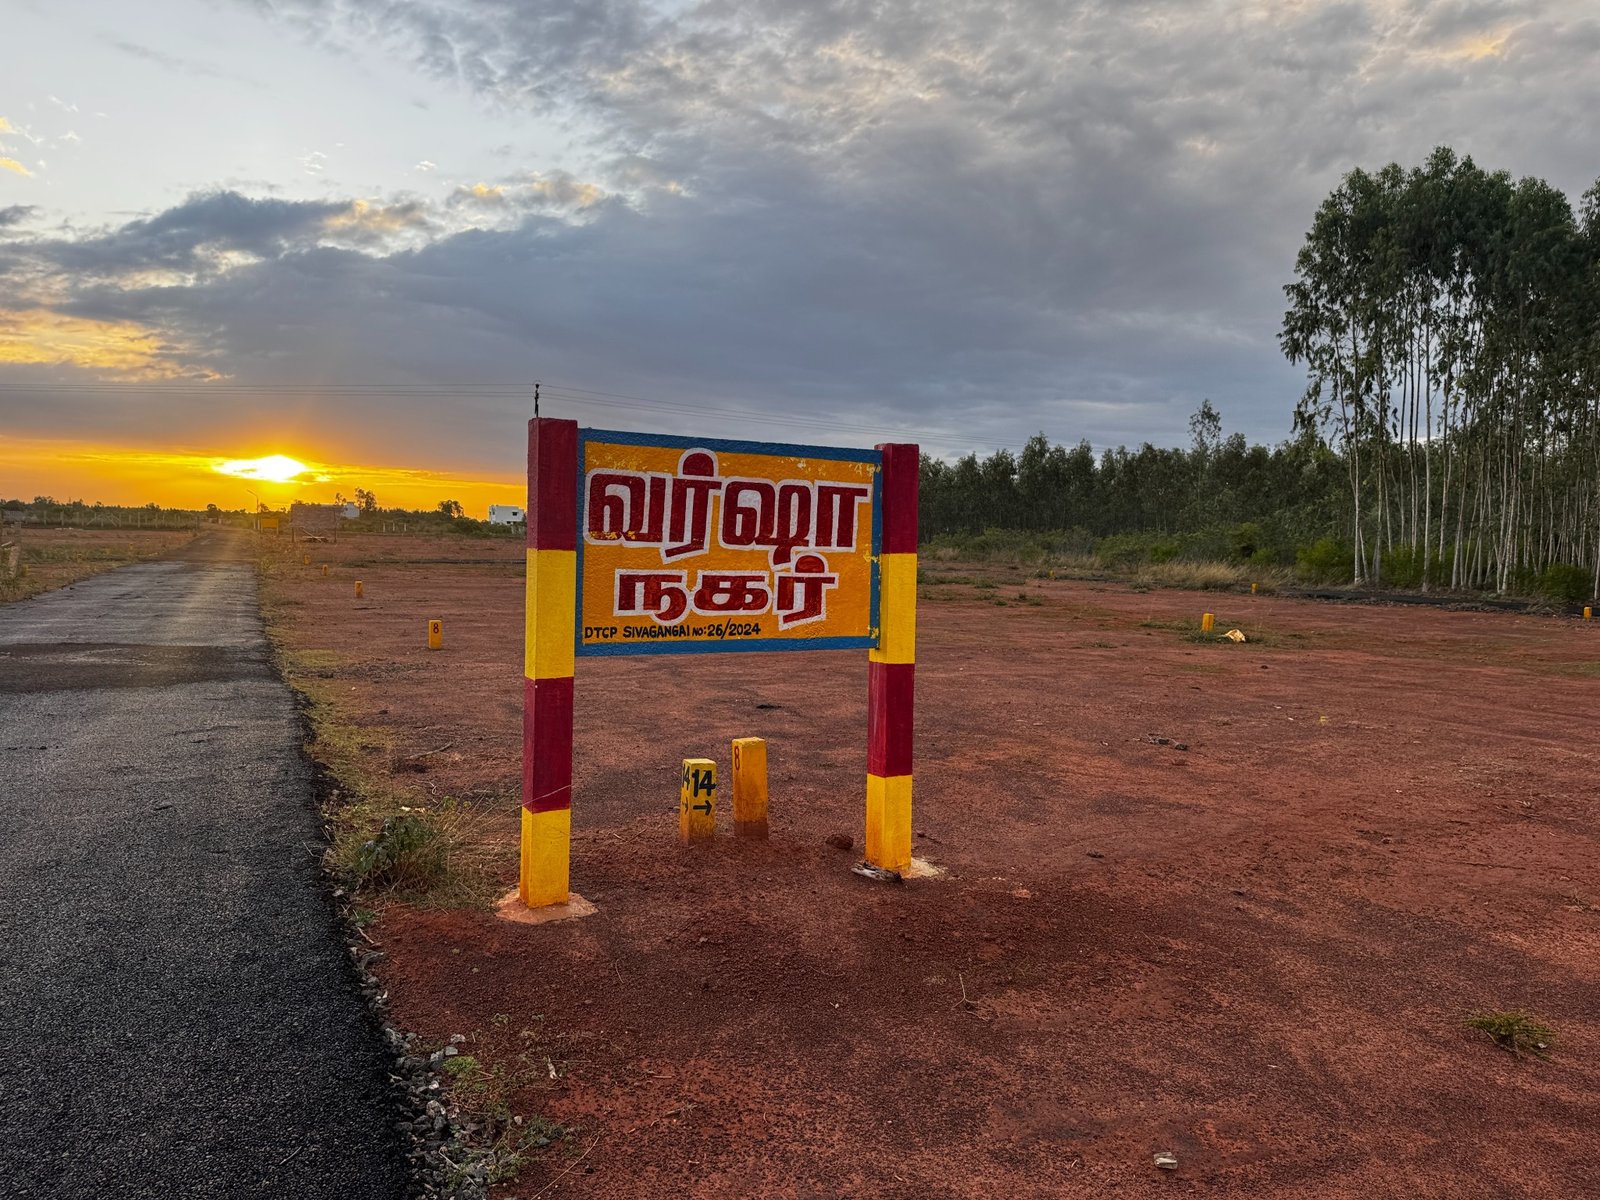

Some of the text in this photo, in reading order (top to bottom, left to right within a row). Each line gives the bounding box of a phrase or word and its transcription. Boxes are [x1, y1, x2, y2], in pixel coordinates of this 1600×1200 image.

[585, 449, 872, 569] வர்ஷா
[615, 553, 838, 629] நகர்
[433, 622, 440, 634] 8
[584, 626, 618, 639] DTCP
[622, 624, 690, 638] SIVAGANGAI
[734, 745, 741, 771] 8
[691, 768, 717, 797] 14
